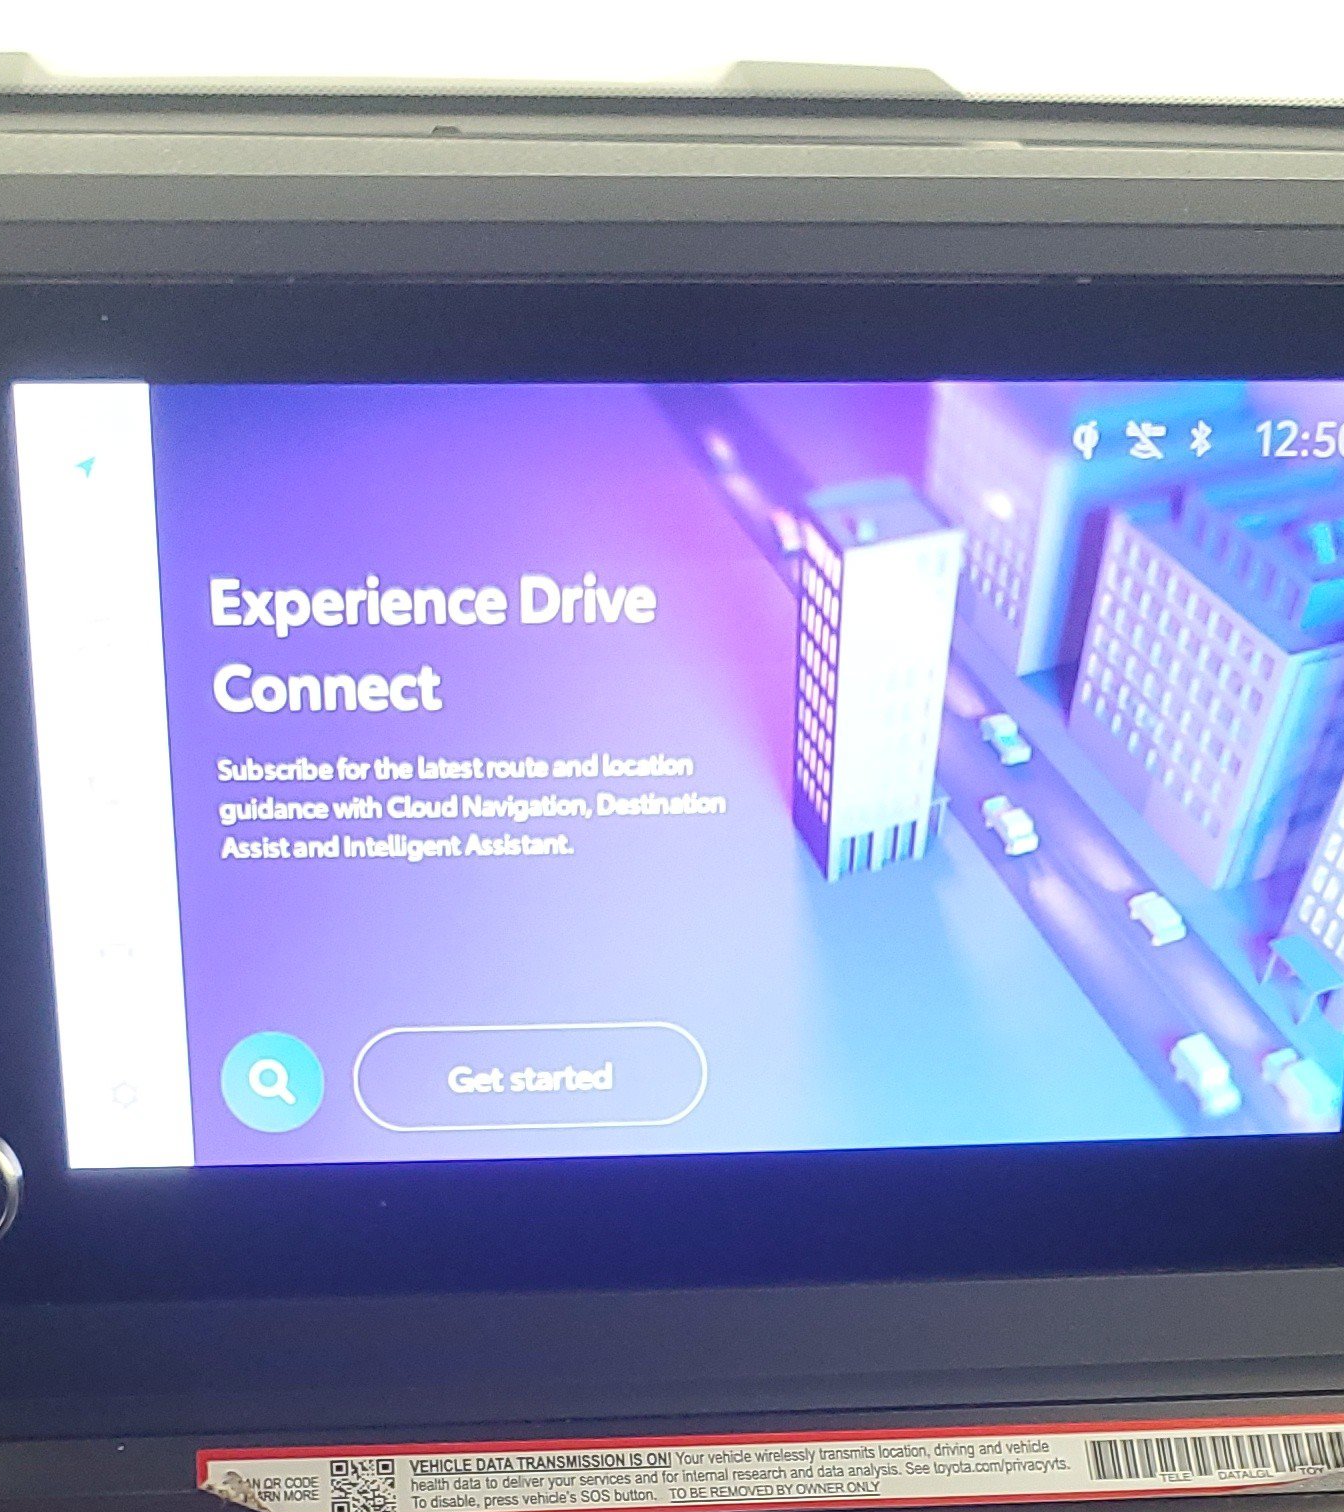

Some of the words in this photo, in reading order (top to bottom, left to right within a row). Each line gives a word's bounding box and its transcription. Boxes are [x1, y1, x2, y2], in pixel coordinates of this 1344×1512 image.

[209, 573, 507, 639] Experience
[520, 571, 657, 627] Drive
[213, 662, 444, 714] Connect
[217, 757, 334, 782] Subscribe
[336, 755, 371, 781] for
[373, 755, 414, 781] the
[417, 754, 485, 780] latest
[486, 757, 549, 779] route
[552, 753, 599, 778] and
[602, 753, 695, 777] location
[219, 796, 330, 826] guidance
[332, 795, 383, 820] with
[386, 794, 458, 819] Cloud
[462, 793, 593, 823] Navigation,
[596, 791, 727, 817] Destination
[221, 836, 291, 859] Assist
[292, 834, 340, 859] and
[343, 833, 463, 862] Intelligent
[464, 832, 575, 857] Assistant.
[447, 1066, 505, 1096] Get
[510, 1062, 614, 1093] started
[409, 1458, 472, 1473] VEHICLE
[476, 1457, 514, 1472] DATA
[516, 1453, 625, 1471] TRANSMISSION
[630, 1453, 642, 1467] IS
[676, 1451, 705, 1465] Your
[707, 1450, 752, 1464] vehicle
[755, 1447, 815, 1464] wirelessly
[819, 1446, 875, 1460] transmits
[878, 1444, 931, 1459] location,
[934, 1442, 975, 1458] driving
[979, 1441, 1002, 1455] and
[1006, 1439, 1050, 1455] vehicle
[284, 1476, 319, 1489] CODE
[410, 1477, 450, 1492] health
[453, 1477, 481, 1490] data
[485, 1476, 498, 1490] to
[502, 1475, 545, 1489] deliver
[548, 1475, 576, 1490] your
[579, 1472, 631, 1487] services
[635, 1471, 658, 1484] and
[662, 1469, 679, 1483] for
[682, 1468, 728, 1483] internal
[732, 1466, 786, 1481] research
[790, 1465, 813, 1479] and
[817, 1464, 844, 1478] data
[848, 1463, 902, 1479] analysis.
[906, 1461, 930, 1475] See
[933, 1457, 1071, 1477] toyota.com/privacyvts.
[283, 1489, 319, 1502] MORE
[411, 1495, 427, 1509] To
[430, 1494, 480, 1509] disable,
[484, 1495, 519, 1509] press
[522, 1490, 577, 1505] vehicle's
[580, 1489, 611, 1503] SOS
[614, 1489, 658, 1502] button.
[669, 1487, 687, 1500] TO
[690, 1486, 707, 1498] BE
[710, 1485, 774, 1498] REMOVED
[777, 1484, 794, 1496] BY
[796, 1482, 844, 1495] OWNER
[847, 1481, 880, 1493] ONLY
